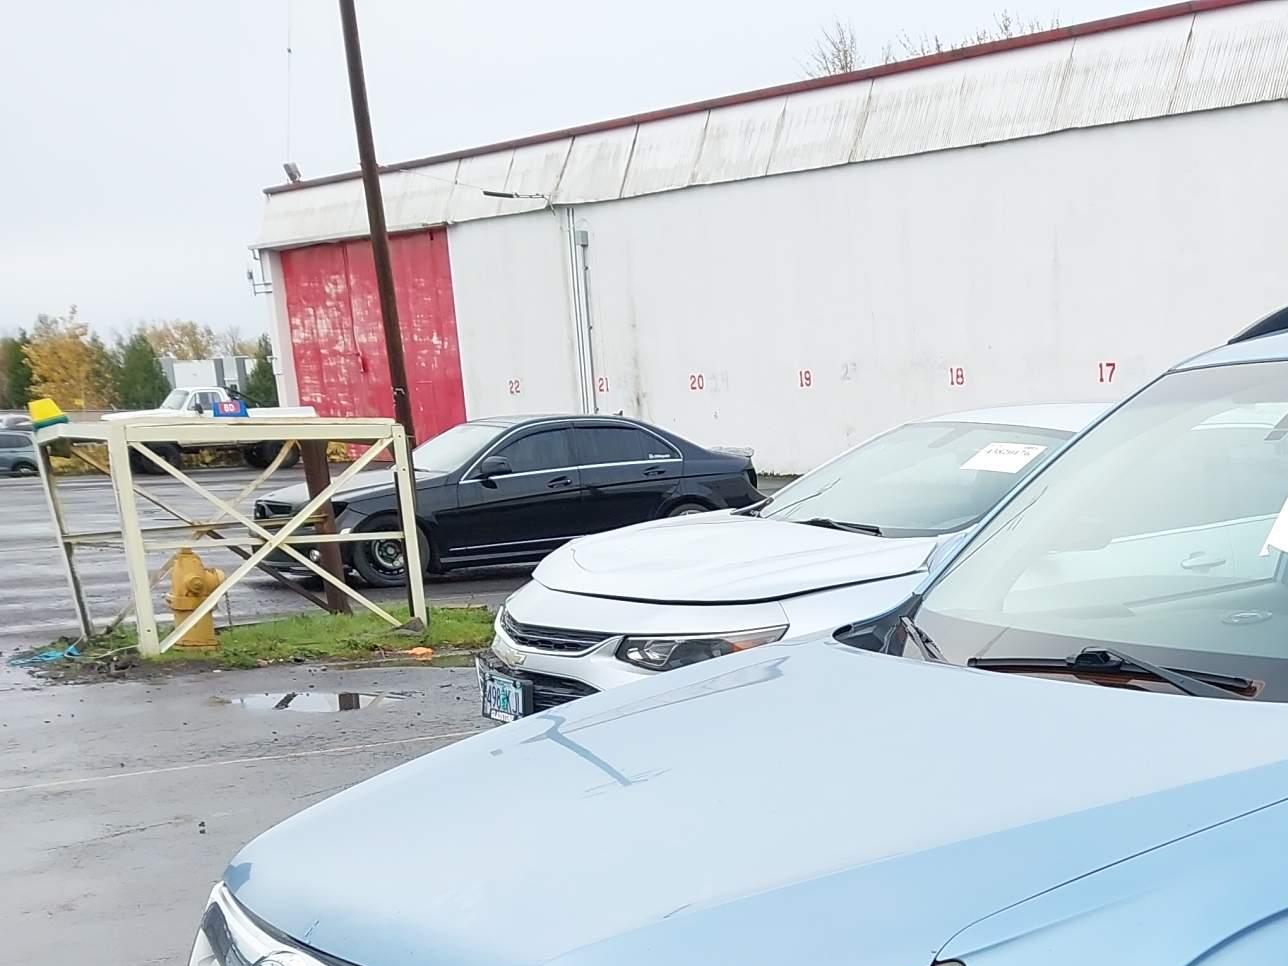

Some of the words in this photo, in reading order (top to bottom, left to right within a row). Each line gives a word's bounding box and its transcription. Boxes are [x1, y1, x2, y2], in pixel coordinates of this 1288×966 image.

[799, 370, 812, 387] 19
[949, 367, 965, 386] 18
[1098, 362, 1116, 383] 17
[508, 379, 521, 395] 22
[598, 376, 610, 393] 21
[689, 374, 705, 391] 20
